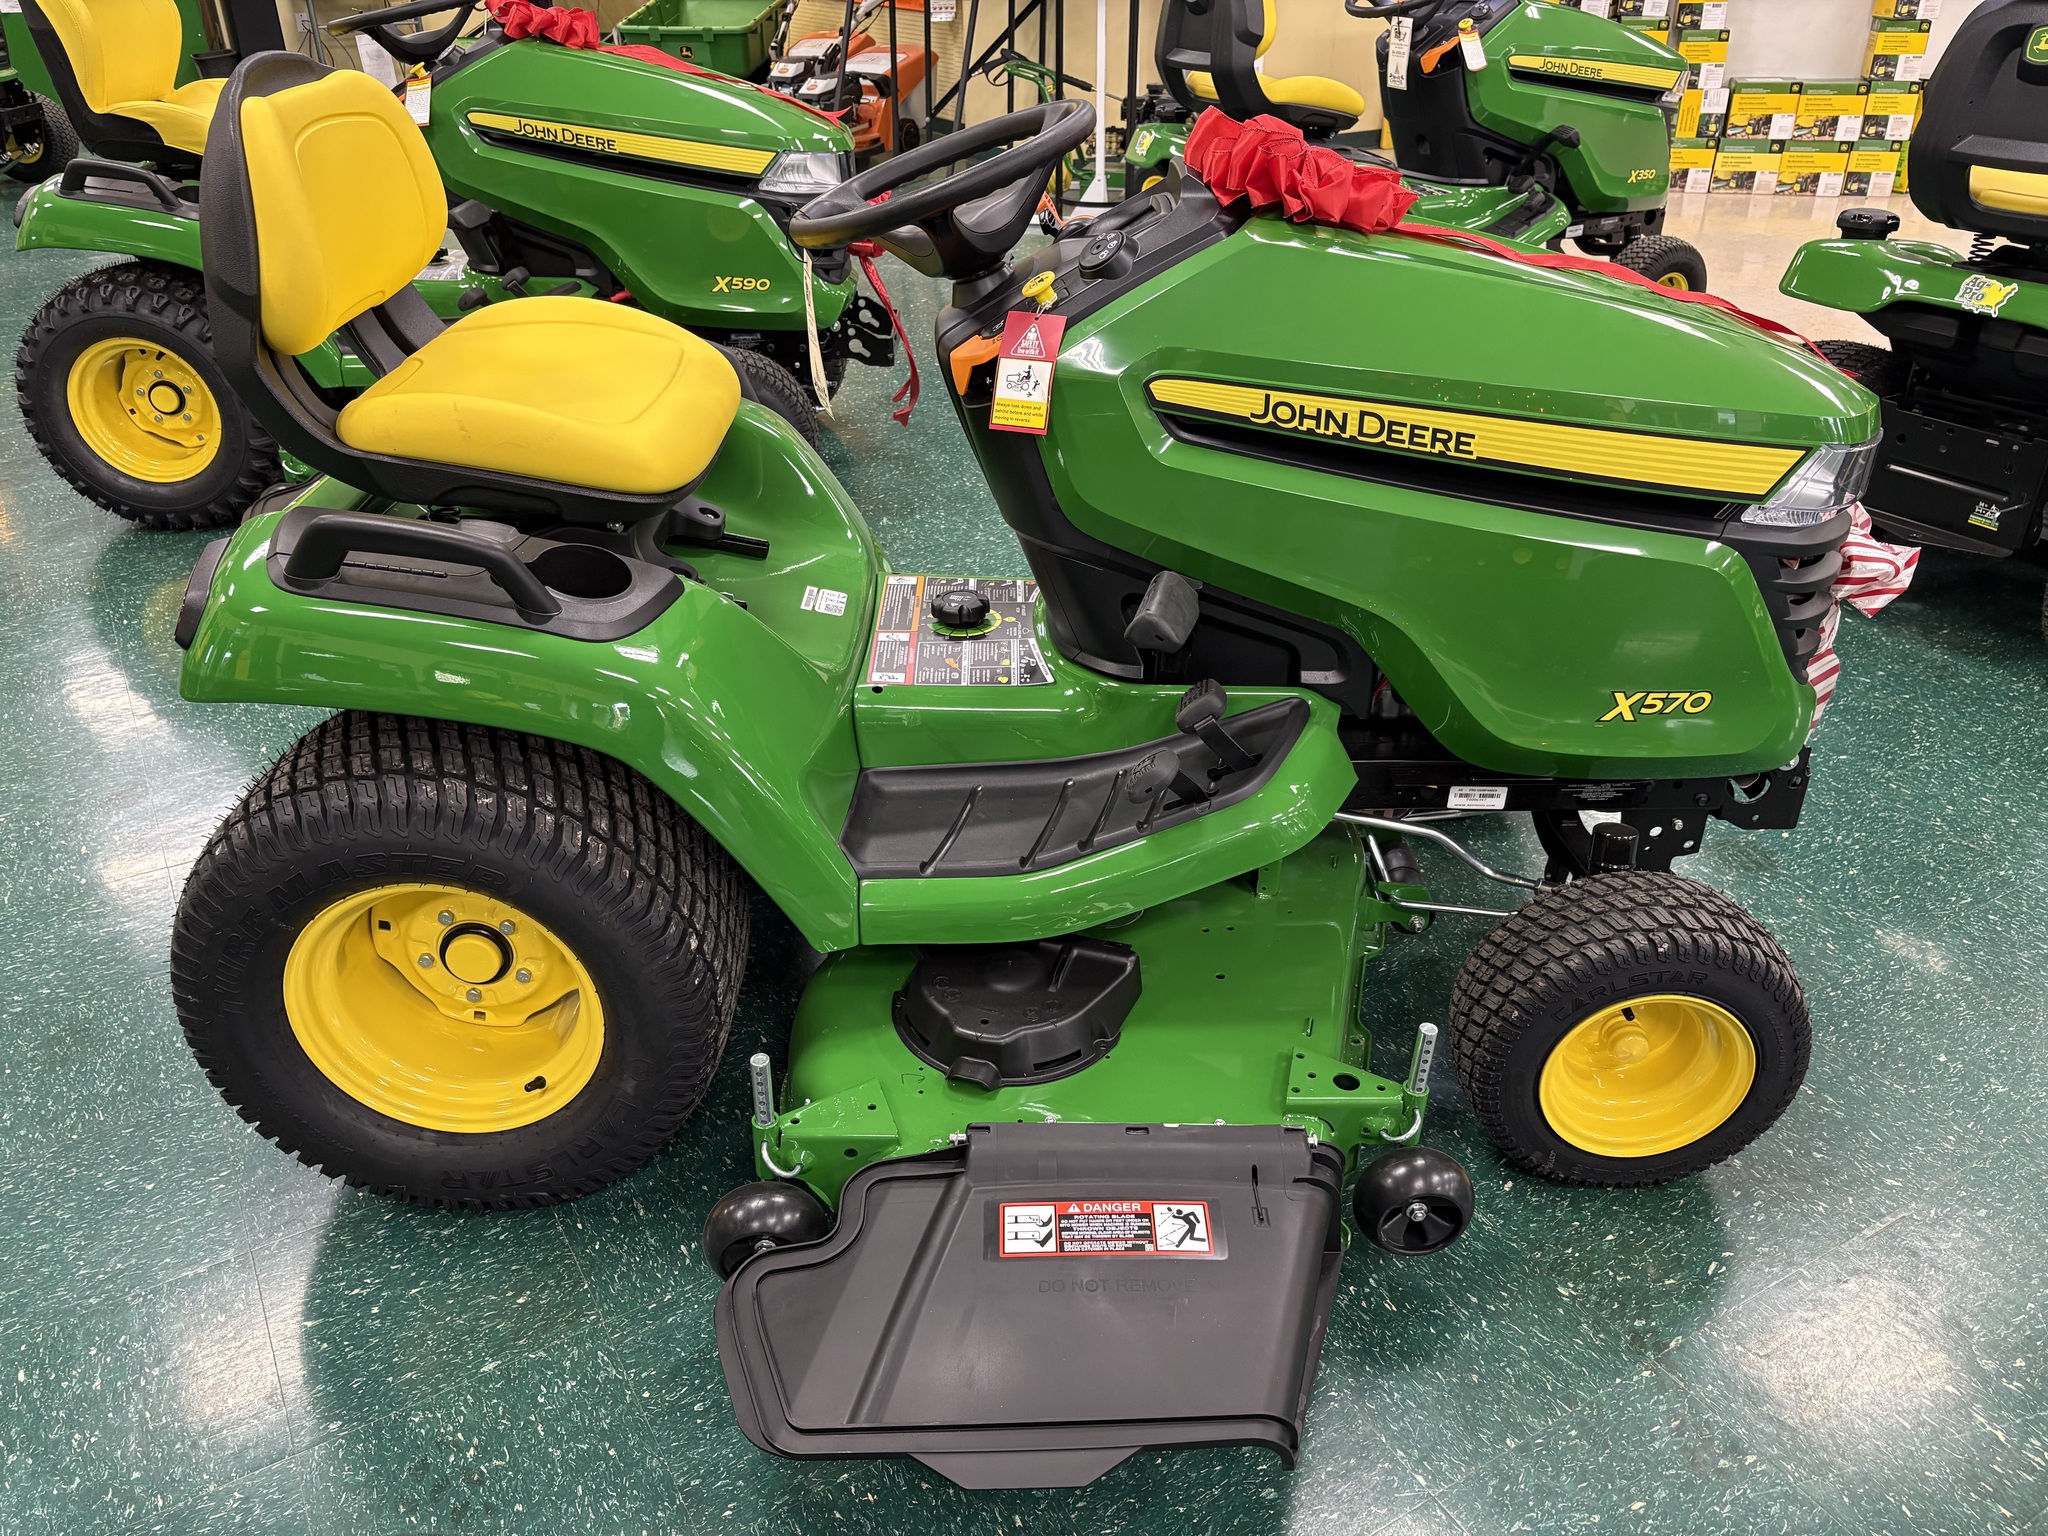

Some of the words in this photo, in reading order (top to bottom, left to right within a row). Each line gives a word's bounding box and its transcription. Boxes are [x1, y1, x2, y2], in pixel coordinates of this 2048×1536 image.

[1539, 59, 1569, 73] JOHN
[1569, 63, 1603, 78] DEERE
[514, 119, 558, 141] JOHN
[561, 129, 618, 152] DEERE
[1627, 168, 1656, 184] X350
[711, 275, 771, 293] X590
[1960, 287, 1985, 301] Pro
[1020, 339, 1040, 348] SAFETY
[1250, 393, 1349, 436] JOHN
[1357, 409, 1477, 458] DEERE
[1595, 690, 1714, 722] X570
[213, 904, 265, 1018] TURF
[265, 851, 508, 913] MASTER
[1551, 970, 1709, 1024] CARLSTAR
[1083, 1203, 1141, 1212] DANGER
[1038, 1280, 1066, 1294] DO
[1072, 1279, 1110, 1293] NOT
[1116, 1279, 1198, 1293] REMOVE
